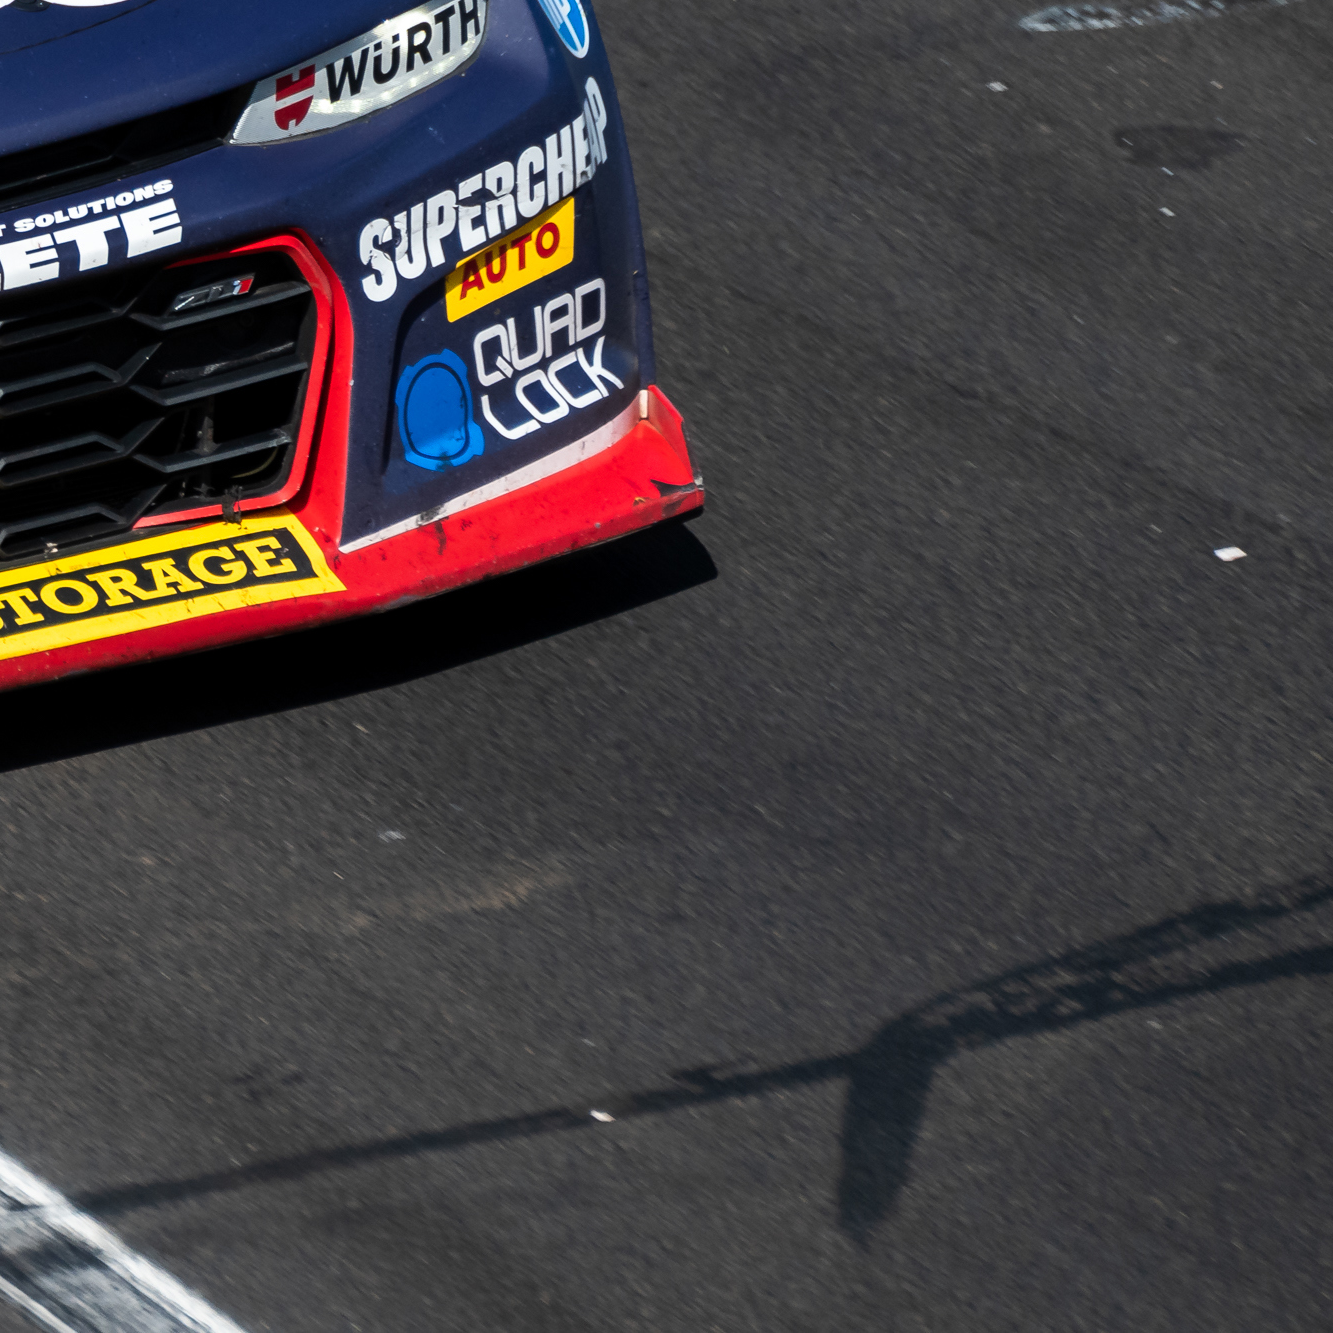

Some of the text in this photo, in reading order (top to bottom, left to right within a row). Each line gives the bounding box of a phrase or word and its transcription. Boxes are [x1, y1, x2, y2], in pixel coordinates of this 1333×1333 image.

[13, 178, 174, 233] SOLUTIONS
[359, 77, 607, 302] SUPERCHEAP
[459, 222, 561, 300] AUTO
[473, 278, 606, 387] QUAD
[481, 335, 624, 440] LOCK
